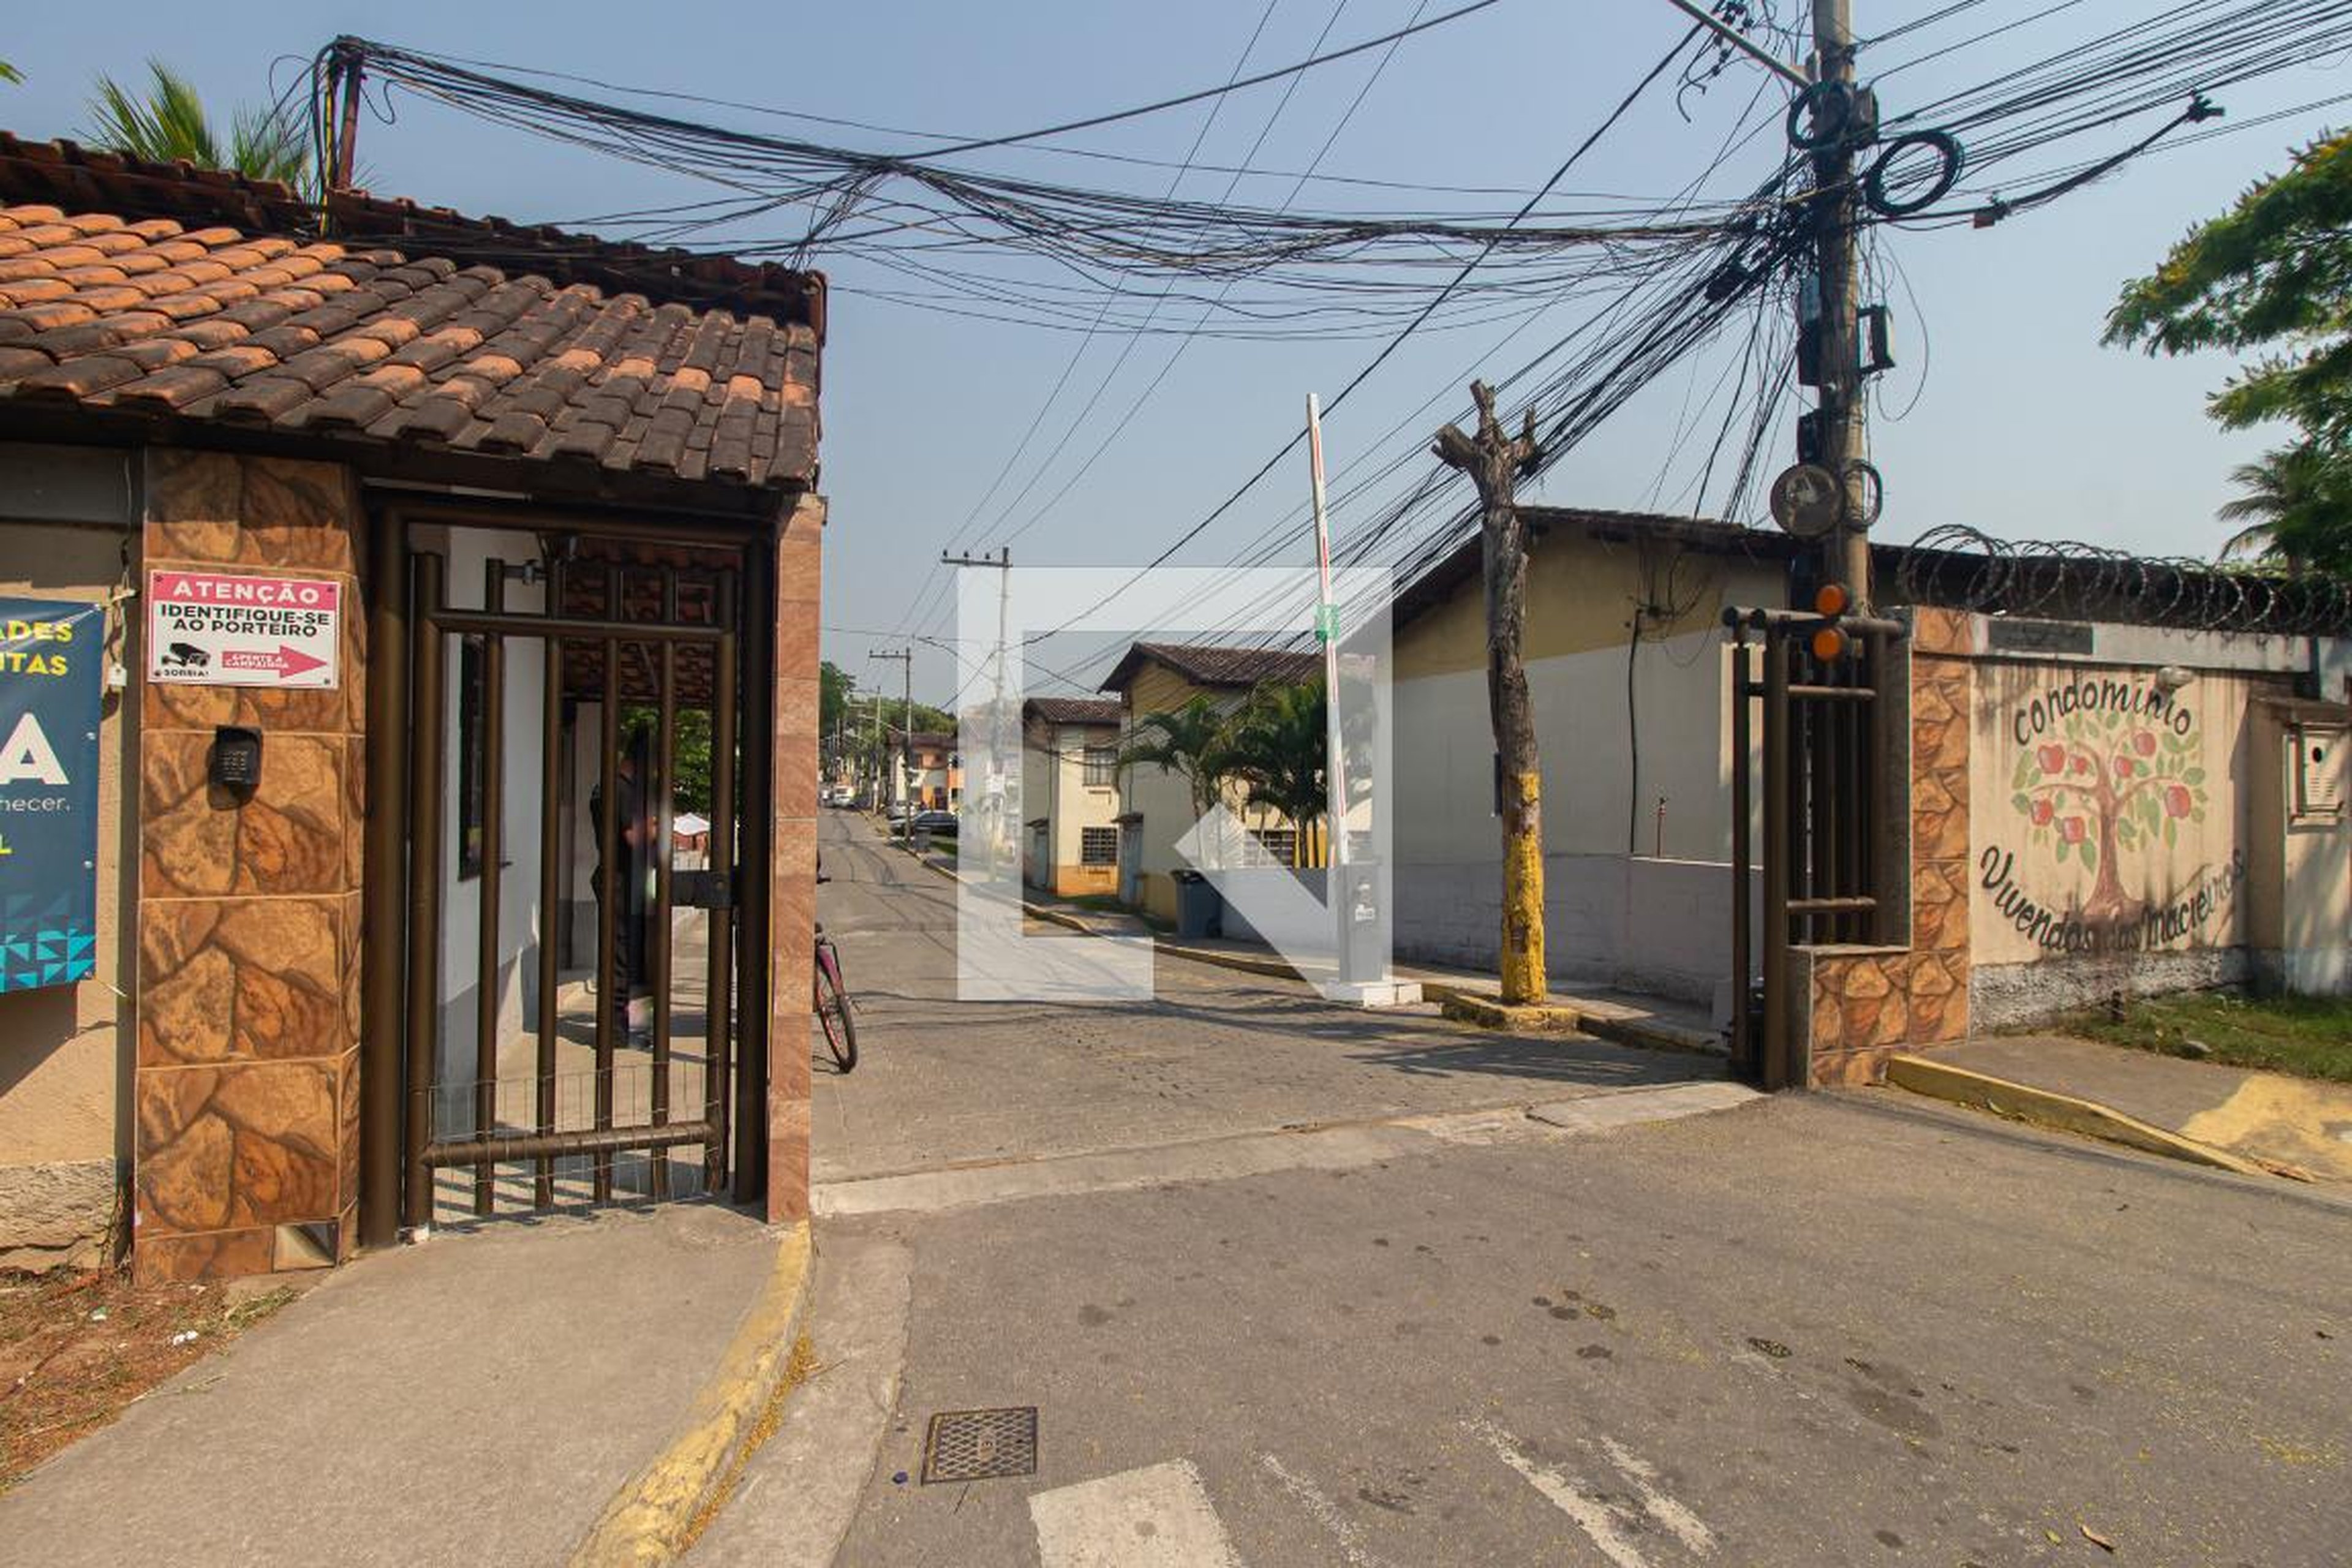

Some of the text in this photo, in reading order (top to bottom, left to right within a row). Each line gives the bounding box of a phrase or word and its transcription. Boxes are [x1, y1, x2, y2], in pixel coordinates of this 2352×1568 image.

[173, 579, 320, 603] ATENÇÃO
[160, 603, 330, 625] IDENTIFIQUE-SE
[0, 619, 73, 643] DES
[173, 618, 317, 637] AO PORTEIRO
